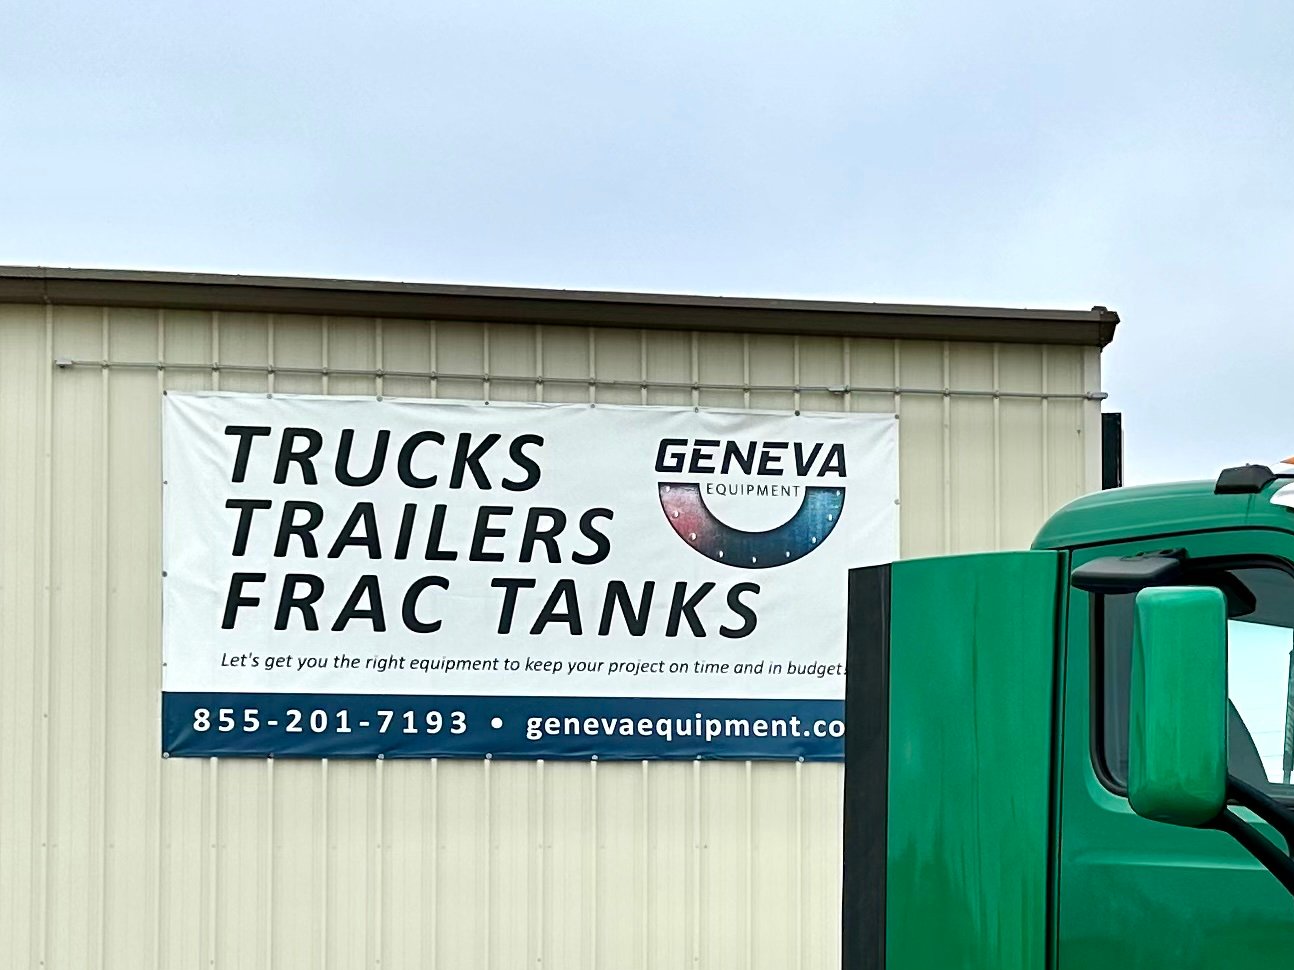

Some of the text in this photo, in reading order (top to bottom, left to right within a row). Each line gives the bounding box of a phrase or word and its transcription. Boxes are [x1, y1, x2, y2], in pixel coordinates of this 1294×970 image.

[224, 425, 545, 492] TRUCKS
[655, 438, 847, 477] GENEVA
[706, 482, 801, 497] EQUIPMENT
[224, 499, 615, 565] TRAILERS
[221, 572, 761, 640] FRAC TANKS
[220, 653, 260, 668] Let's
[265, 654, 293, 671] get
[297, 655, 328, 671] you
[333, 654, 361, 669] the
[365, 655, 405, 672] right
[410, 656, 499, 673] equipment
[504, 658, 520, 671] to
[525, 657, 563, 673] keep
[568, 660, 605, 675] your
[608, 658, 666, 676] project
[669, 661, 689, 674] on
[694, 659, 730, 674] time
[734, 660, 763, 675] and
[768, 660, 783, 675] in
[193, 707, 468, 734] 855-201-7193
